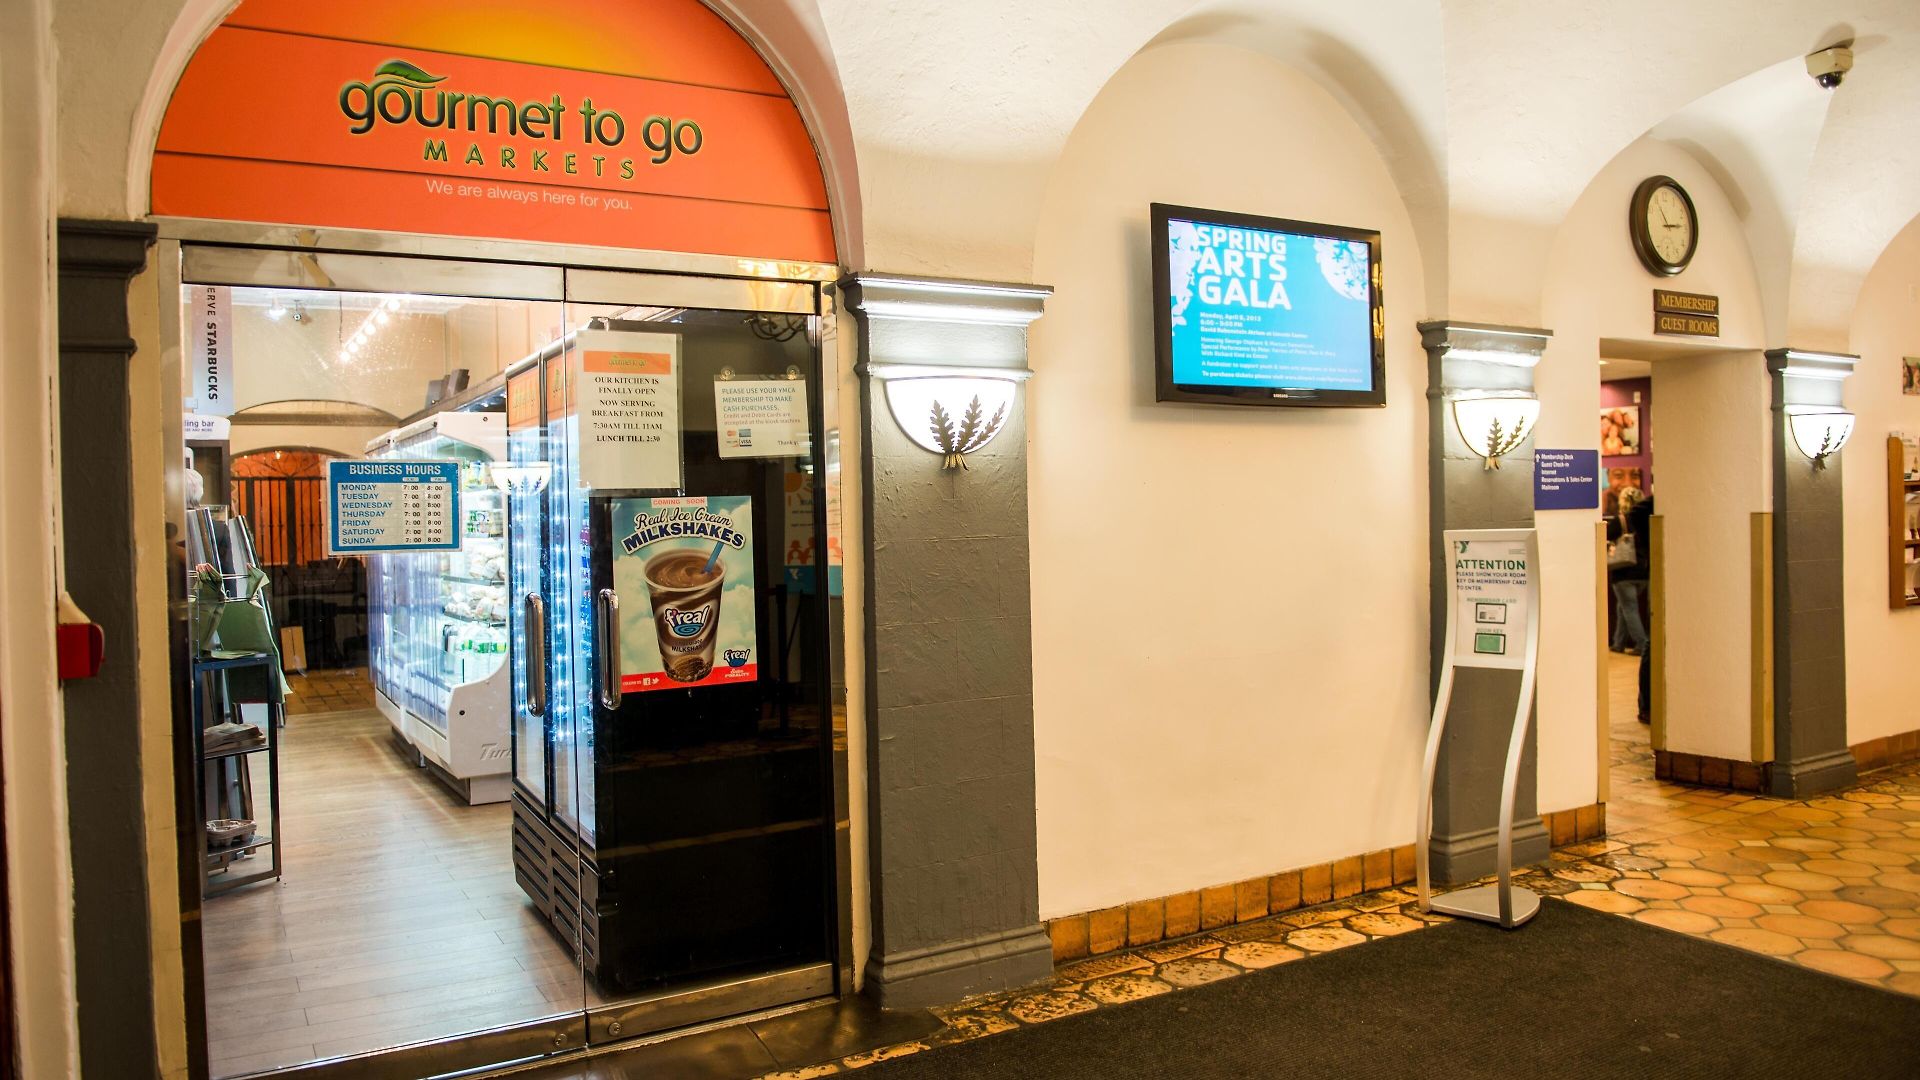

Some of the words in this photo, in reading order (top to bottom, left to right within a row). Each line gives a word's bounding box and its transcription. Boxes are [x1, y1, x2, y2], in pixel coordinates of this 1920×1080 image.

[339, 80, 566, 142] gourmet
[580, 98, 626, 148] to
[642, 116, 704, 165] go
[423, 139, 635, 180] MARKETS
[426, 178, 454, 196] We
[457, 185, 483, 199] are
[487, 186, 538, 205] always
[543, 190, 576, 206] here
[580, 191, 599, 208] for
[603, 196, 633, 212] you.
[1196, 226, 1287, 255] SPRING
[1196, 246, 1288, 283] ARTS
[1198, 275, 1293, 311] GALA
[1660, 293, 1717, 312] MEMBERSHIP
[1660, 316, 1687, 332] GUEST
[1688, 318, 1718, 335] ROOMS
[206, 322, 219, 400] STARBUCKS
[594, 376, 613, 384] OUR
[721, 387, 745, 395] PLEASE
[745, 386, 758, 394] USE
[759, 386, 777, 394] YOUR
[779, 386, 796, 394] YMCA
[201, 419, 215, 427] bar
[640, 410, 663, 418] FROM
[646, 435, 661, 443] 2:30
[349, 464, 403, 475] BUSINESS
[405, 464, 441, 475] HOURS
[635, 508, 667, 530] Real
[669, 507, 690, 522] Ice
[694, 507, 731, 527] Cream
[342, 528, 385, 536] SATURDAY
[622, 522, 745, 553] MILKSHAKES
[1456, 559, 1527, 570] ATTENTION
